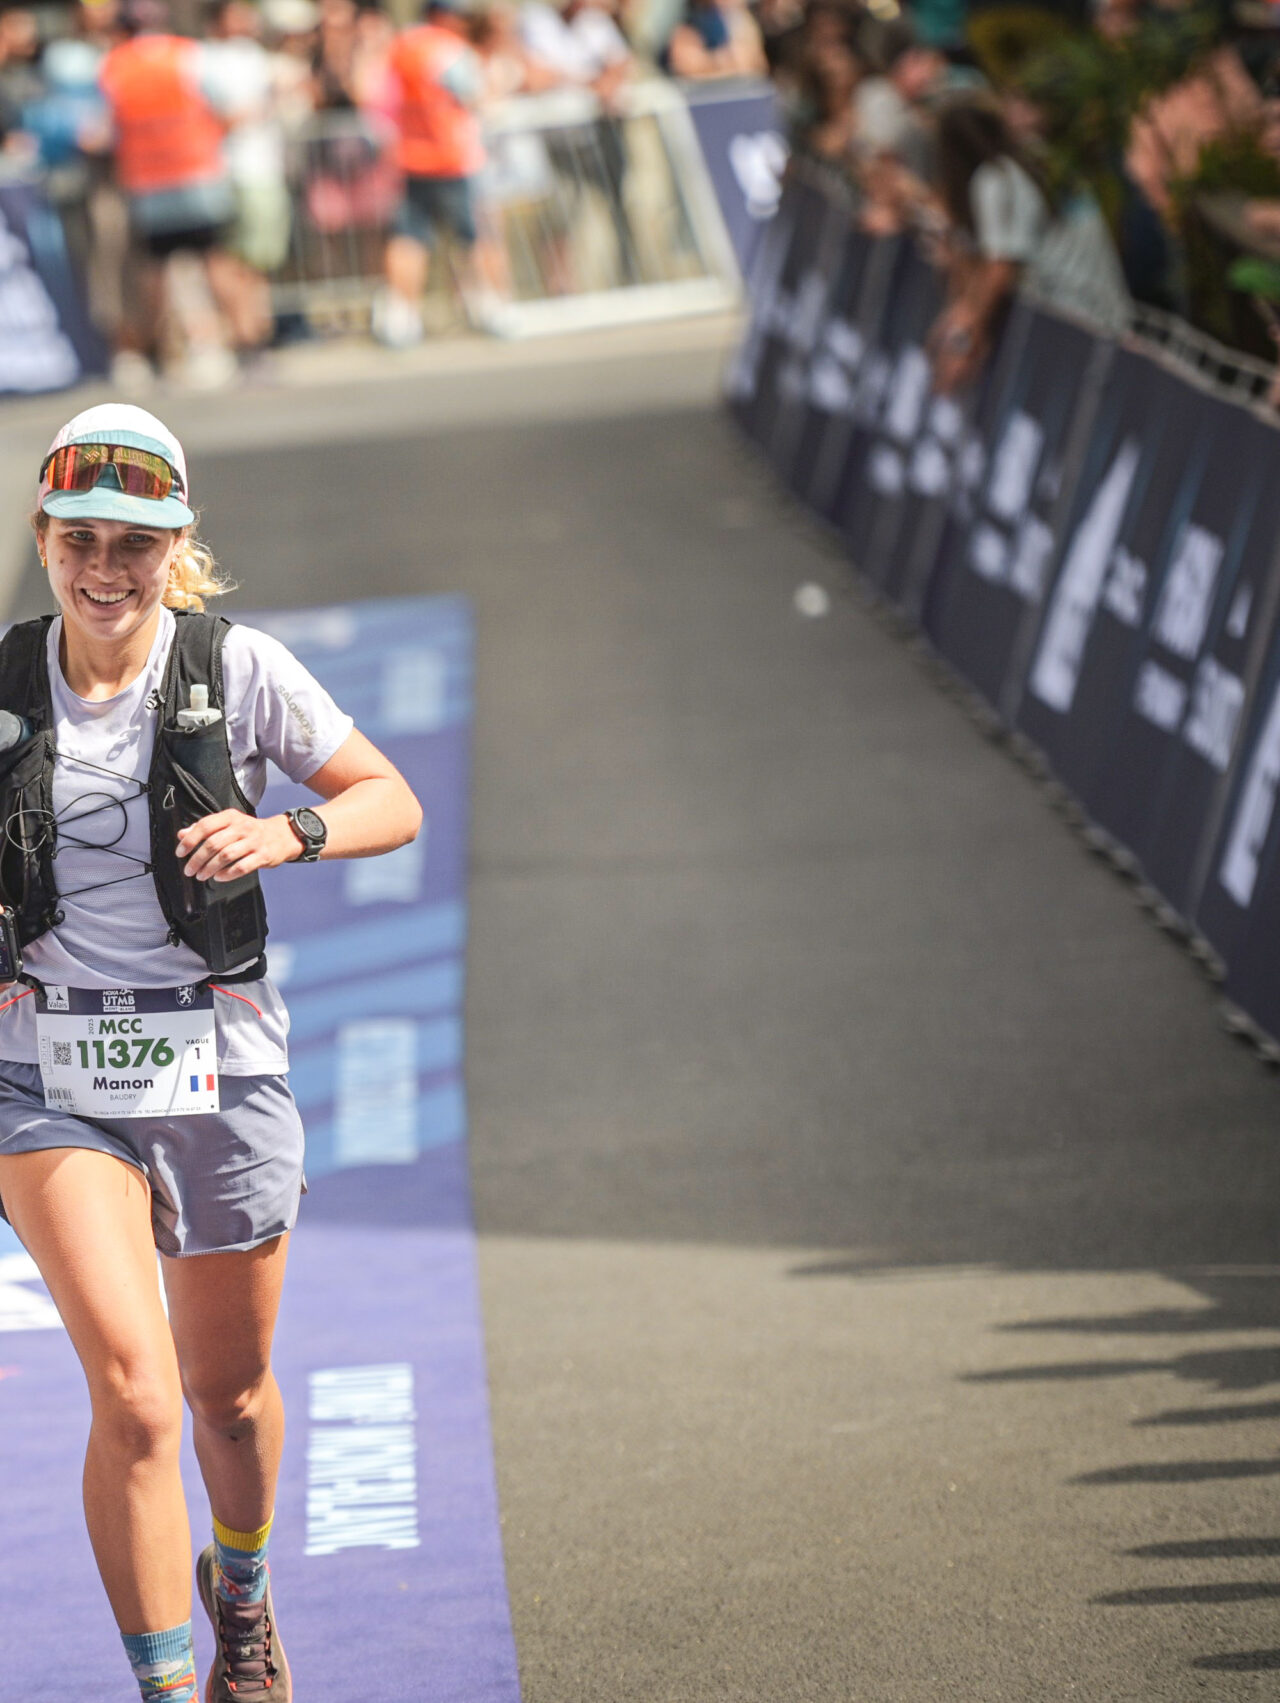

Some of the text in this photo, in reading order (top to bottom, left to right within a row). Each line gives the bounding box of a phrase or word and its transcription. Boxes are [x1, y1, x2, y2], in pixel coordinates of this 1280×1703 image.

[276, 684, 317, 736] SALOMON
[48, 1000, 68, 1010] Valais
[103, 995, 135, 1006] UTMB
[98, 1018, 143, 1035] MCC
[185, 1038, 210, 1046] VAGUE
[77, 1037, 175, 1069] 11376
[195, 1047, 201, 1060] 1
[93, 1076, 154, 1091] Manon
[109, 1093, 137, 1101] BAUDRY
